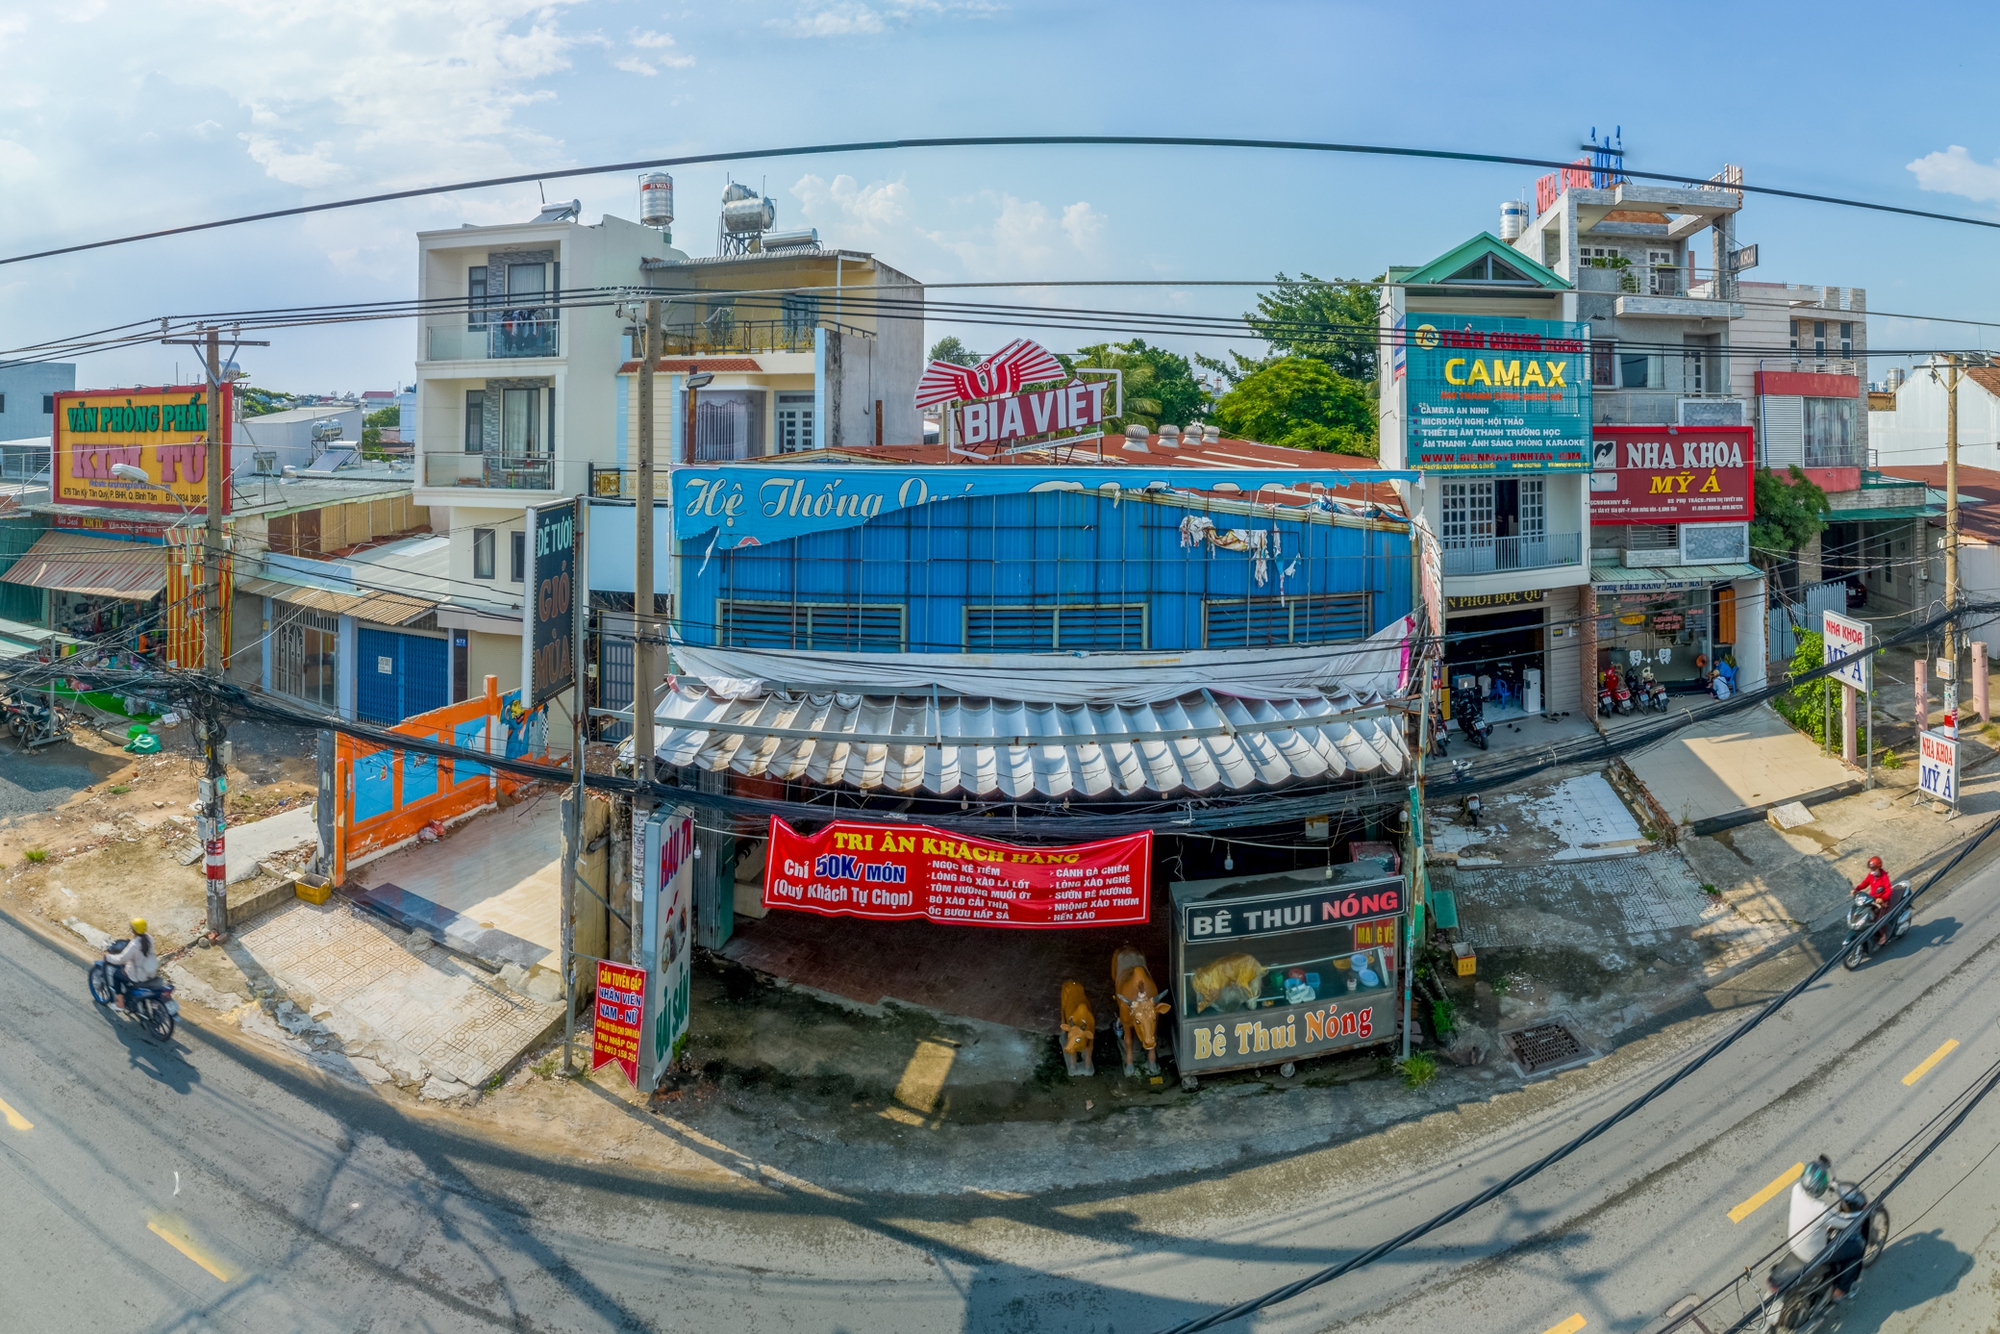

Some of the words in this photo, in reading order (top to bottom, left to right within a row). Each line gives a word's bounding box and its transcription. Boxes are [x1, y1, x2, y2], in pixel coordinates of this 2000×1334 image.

[1536, 172, 1557, 215] NHA
[1444, 358, 1567, 388] CAMAX
[67, 401, 98, 432] VĂN
[100, 399, 160, 432] PHÒNG
[963, 396, 1025, 445] BIA
[1029, 377, 1109, 432] VIỆT
[1449, 416, 1462, 427] HỘI
[1488, 416, 1501, 427] HỘI
[1422, 426, 1447, 436] THIẾT
[1460, 428, 1473, 436] ÂM
[1543, 428, 1561, 438] HỌC
[1491, 438, 1513, 447] SÁNG
[1516, 438, 1543, 446] PHÒNG
[72, 444, 142, 480] KIM
[156, 435, 206, 483] TÚ
[1626, 442, 1676, 469] NHA
[1682, 442, 1744, 468] KHOA
[1649, 471, 1695, 494] MỸ
[1699, 468, 1721, 493] Á
[685, 478, 746, 527] Hệ
[759, 478, 884, 524] Thống
[537, 518, 550, 558] DÊ
[551, 515, 573, 553] TƯƠI
[539, 560, 570, 622] GIÓ
[1826, 619, 1840, 637] NHA
[1842, 627, 1863, 646] KHOA
[535, 628, 572, 693] MÙA
[1922, 736, 1934, 758] NHA
[1936, 742, 1953, 766] KHOA
[1921, 764, 1939, 793] MỸ
[1942, 770, 1952, 797] Á
[660, 825, 680, 892] HÀU
[834, 832, 873, 851] TRI
[880, 831, 916, 853] ÂN
[922, 837, 1004, 862] KHÁCH
[1011, 851, 1080, 865] HÀNG
[784, 858, 809, 879] Chỉ
[814, 854, 863, 881] 50K/
[866, 861, 906, 883] MÓN
[932, 860, 959, 870] NGỌC
[962, 864, 974, 873] KÊ
[1056, 867, 1083, 877] CÁNH
[1086, 867, 1098, 877] GÀ
[1101, 864, 1129, 874] CHIÊN
[774, 878, 803, 900] (Quý
[808, 883, 847, 902] Khách
[851, 886, 868, 907] Tự
[871, 888, 913, 909] Chọn)
[930, 883, 951, 893] TÔM
[991, 888, 1016, 900] MUỐI
[931, 871, 957, 882] LÒNG
[960, 875, 972, 884] BÒ
[975, 877, 995, 887] XÀO
[1012, 878, 1030, 890] LỐT
[1056, 880, 1081, 889] LÒNG
[1083, 878, 1103, 887] XÀO
[1105, 874, 1131, 885] NGHỆ
[929, 894, 943, 904] BÒ
[945, 896, 965, 906] XÀO
[968, 897, 985, 907] CẢI
[987, 900, 1009, 910] THÌA
[1054, 890, 1082, 900] SƯỜN
[1054, 901, 1088, 912] NHỘNG
[1090, 898, 1110, 908] XÀO
[1112, 897, 1139, 906] THƠM
[928, 905, 942, 916] ỐC
[944, 908, 971, 917] BƯƠU
[973, 908, 993, 919] HẤP
[1053, 911, 1073, 921] HẾN
[1075, 910, 1095, 920] XÀO
[1193, 909, 1232, 936] BÊ
[1243, 904, 1312, 931] THUI
[1322, 890, 1398, 920] NÓNG
[1357, 926, 1383, 943] MAG
[630, 972, 642, 991] GẤP
[599, 986, 620, 1003] NHÂN
[622, 991, 642, 1007] VIÊN
[600, 1002, 618, 1020] NAM
[625, 1008, 638, 1025] NỮ
[597, 1031, 608, 1042] THU
[609, 1036, 625, 1048] NHẬP
[626, 1040, 637, 1051] CAO
[1194, 1024, 1227, 1060] Bê
[1234, 1014, 1296, 1055] Thui
[1304, 1005, 1373, 1043] Nóng
